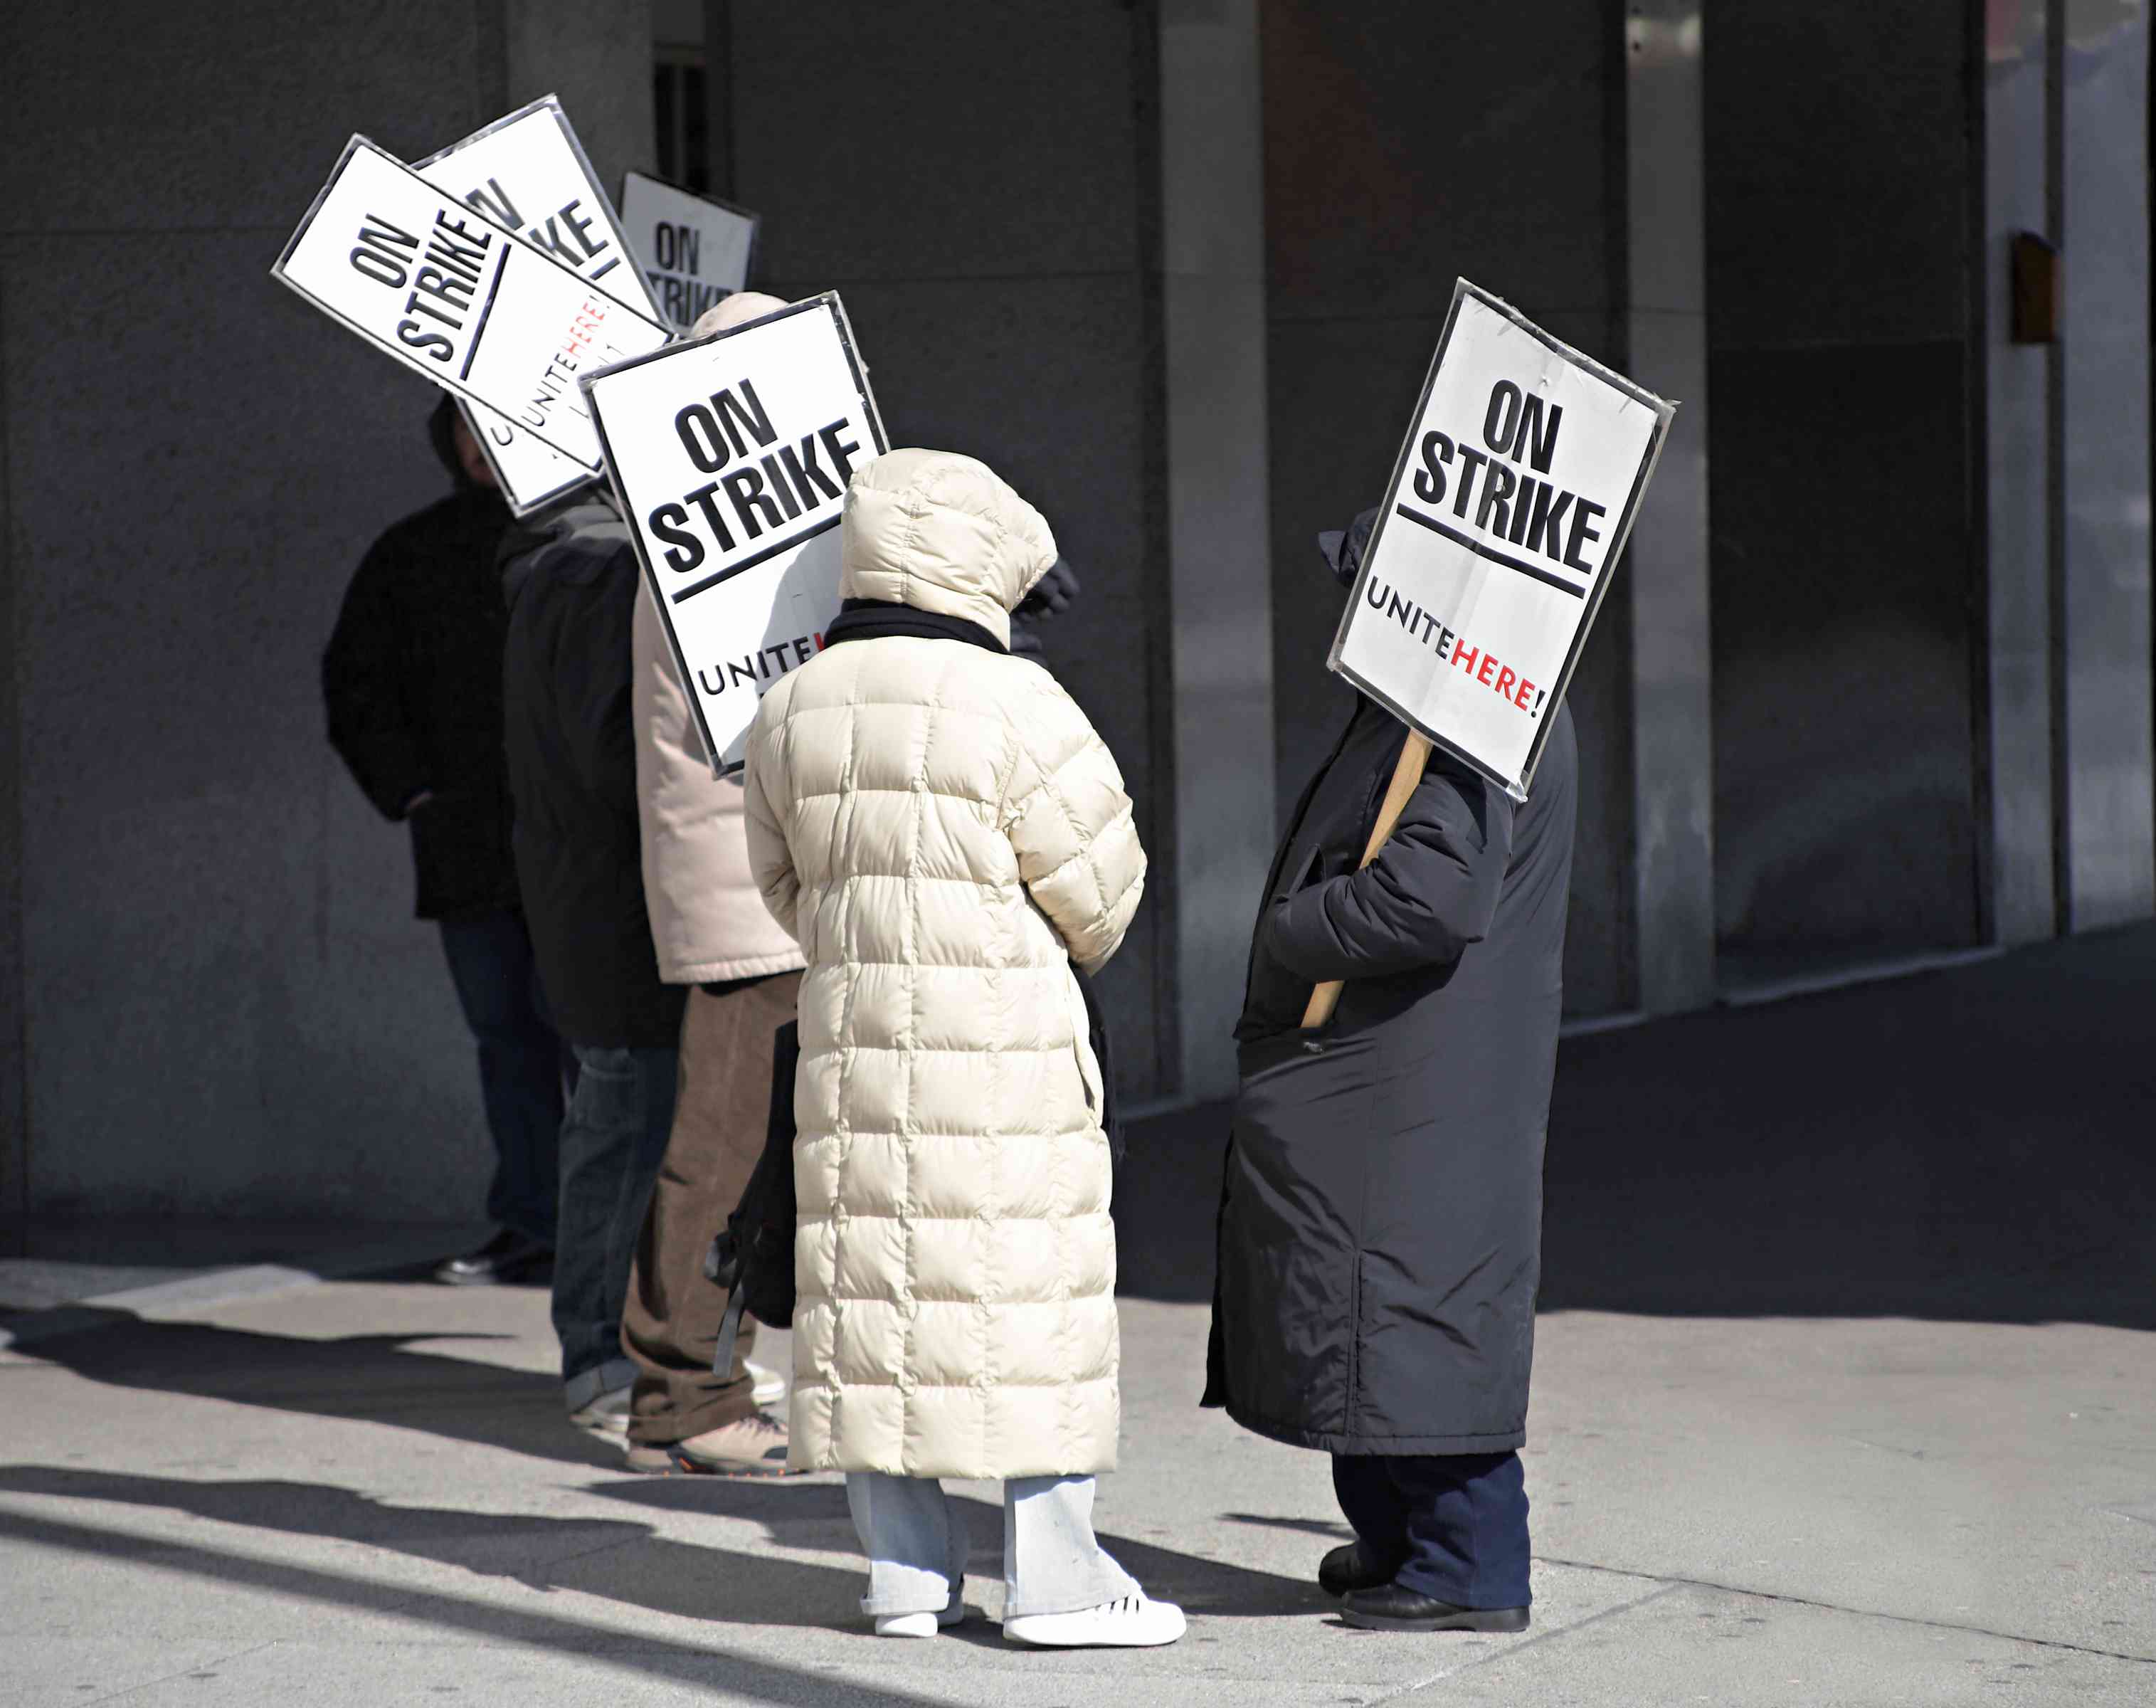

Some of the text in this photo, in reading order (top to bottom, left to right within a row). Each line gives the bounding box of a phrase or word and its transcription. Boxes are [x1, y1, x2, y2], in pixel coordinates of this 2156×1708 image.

[349, 213, 420, 288] ON
[465, 177, 526, 231] N
[656, 221, 700, 275] ON
[396, 209, 492, 362] STRIKE
[674, 378, 778, 473] ON
[1482, 379, 1563, 475] ON
[1413, 431, 1606, 575] STRIKE
[1366, 575, 1546, 718] UNITEHERE!
